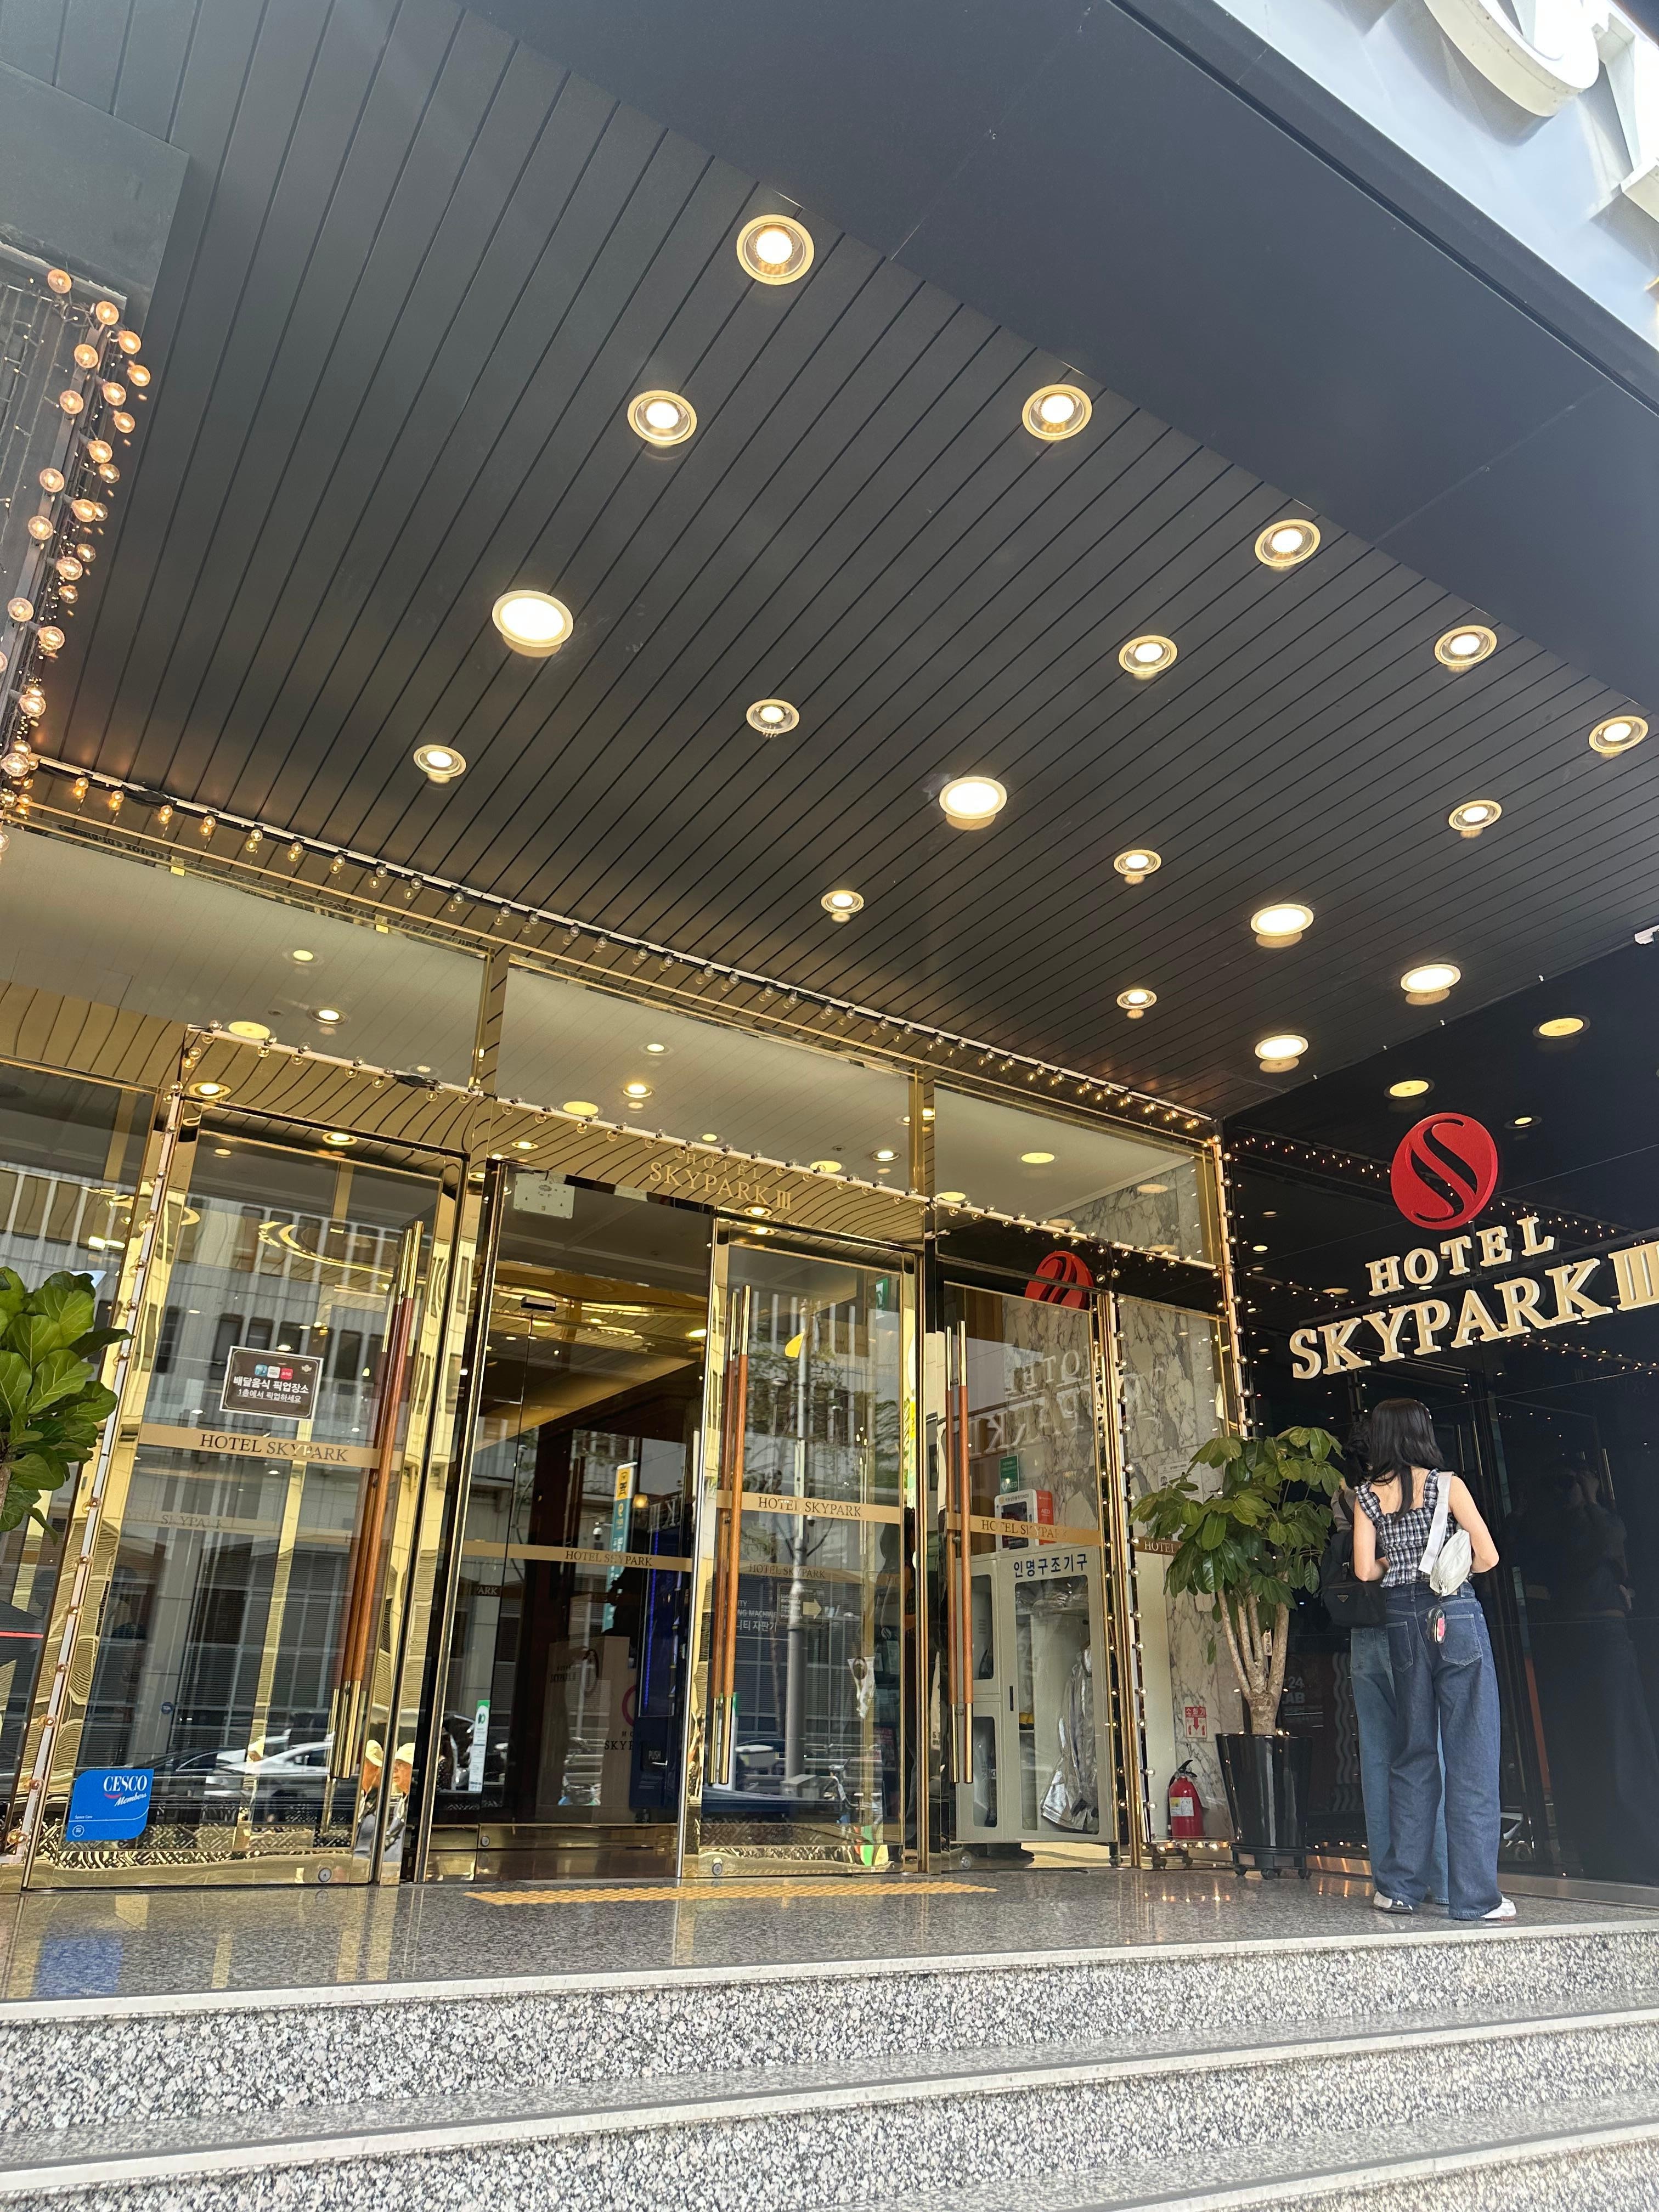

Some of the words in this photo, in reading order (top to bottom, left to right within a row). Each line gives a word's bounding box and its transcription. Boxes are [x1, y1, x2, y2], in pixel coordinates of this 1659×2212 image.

[686, 1153, 760, 1180] HOTEL
[650, 1162, 769, 1206] SKYPARK
[1365, 1216, 1555, 1297] HOTEL
[1289, 1257, 1613, 1379] SKYPARK
[233, 1376, 270, 1390] 배달음식
[273, 1381, 309, 1394] 픽업장소
[238, 1389, 264, 1400] 1층에서
[199, 1434, 262, 1453] HOTEL
[267, 1441, 348, 1462] SKYPARK
[758, 1497, 800, 1511] HOTEL
[805, 1501, 861, 1517] SKYPARK
[981, 1519, 1018, 1534] HOEL
[1144, 1541, 1175, 1553] HOTEL
[565, 1550, 602, 1563] HOTEL
[1013, 1553, 1088, 1578] 인명구조기구
[749, 1564, 781, 1575] HOTEL
[103, 1775, 148, 1792] CESCO
[114, 1792, 147, 1807] Members
